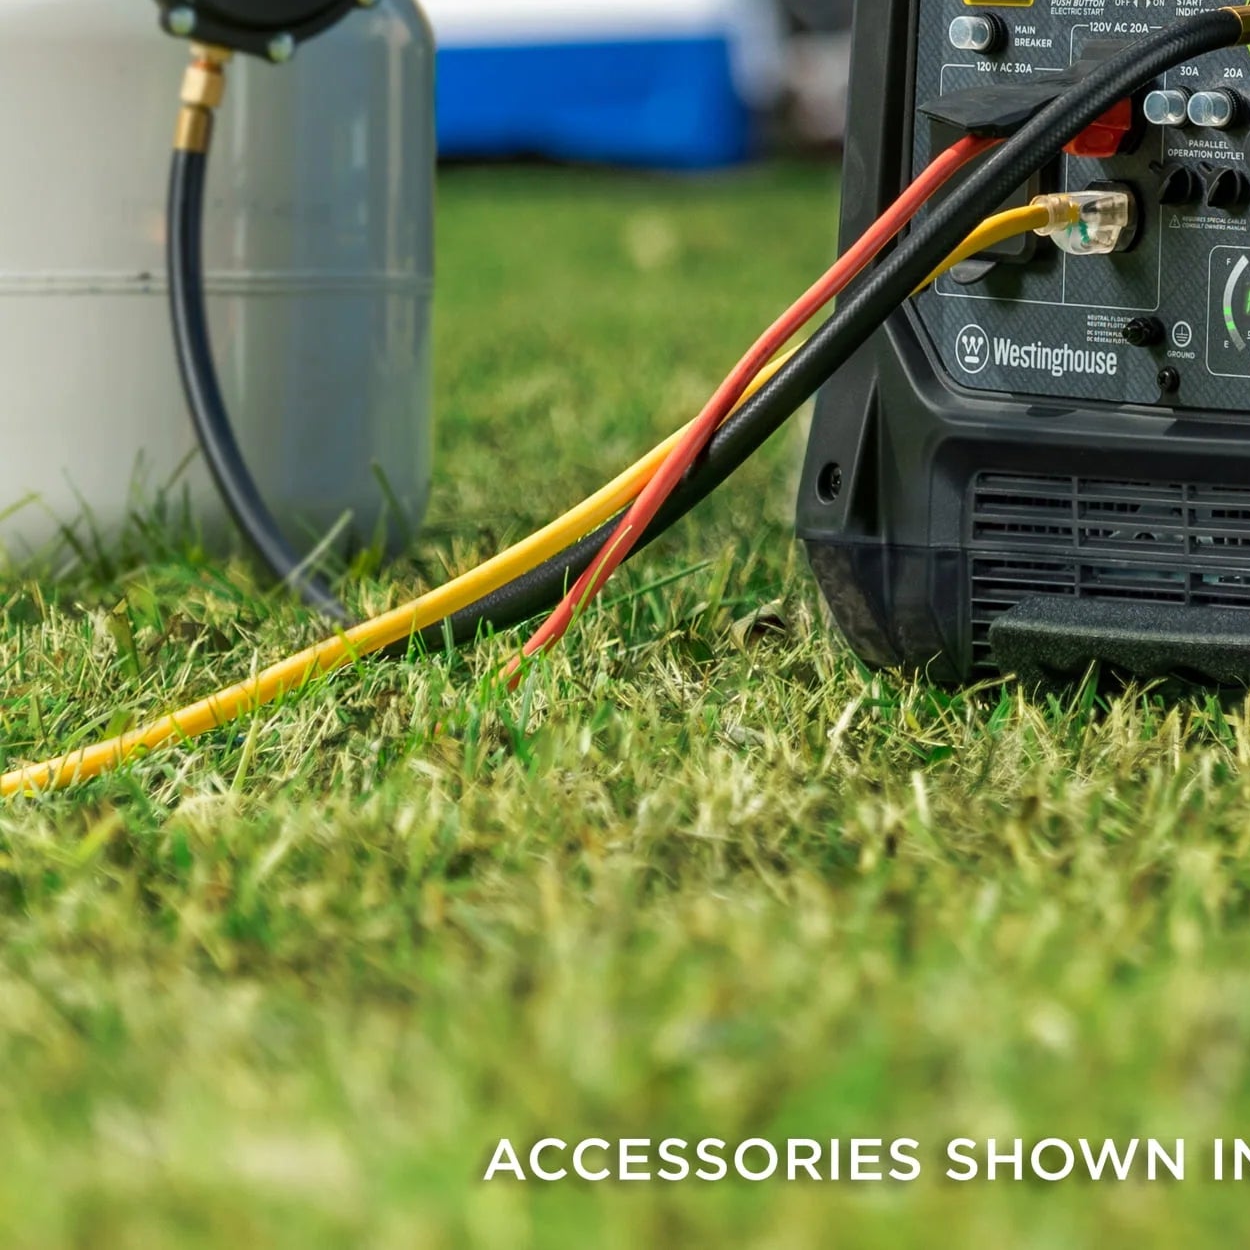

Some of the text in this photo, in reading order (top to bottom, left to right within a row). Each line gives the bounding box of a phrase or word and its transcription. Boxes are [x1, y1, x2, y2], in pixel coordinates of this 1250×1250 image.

[1050, 7, 1105, 16] ELECTRIC START
[1014, 25, 1036, 35] MAIN
[1089, 22, 1149, 34] 120V AC 20A
[1014, 37, 1052, 48] BREAKER
[977, 61, 1033, 74] 120V AC 30A
[1180, 66, 1200, 77] 30A
[1223, 67, 1244, 78] 20A
[1188, 139, 1229, 149] PARALLEL
[1168, 148, 1245, 160] OPERATION OUTLET
[1226, 258, 1232, 266] F
[1223, 340, 1230, 349] E
[993, 336, 1118, 377] Westinghouse
[1167, 350, 1196, 360] GROUND
